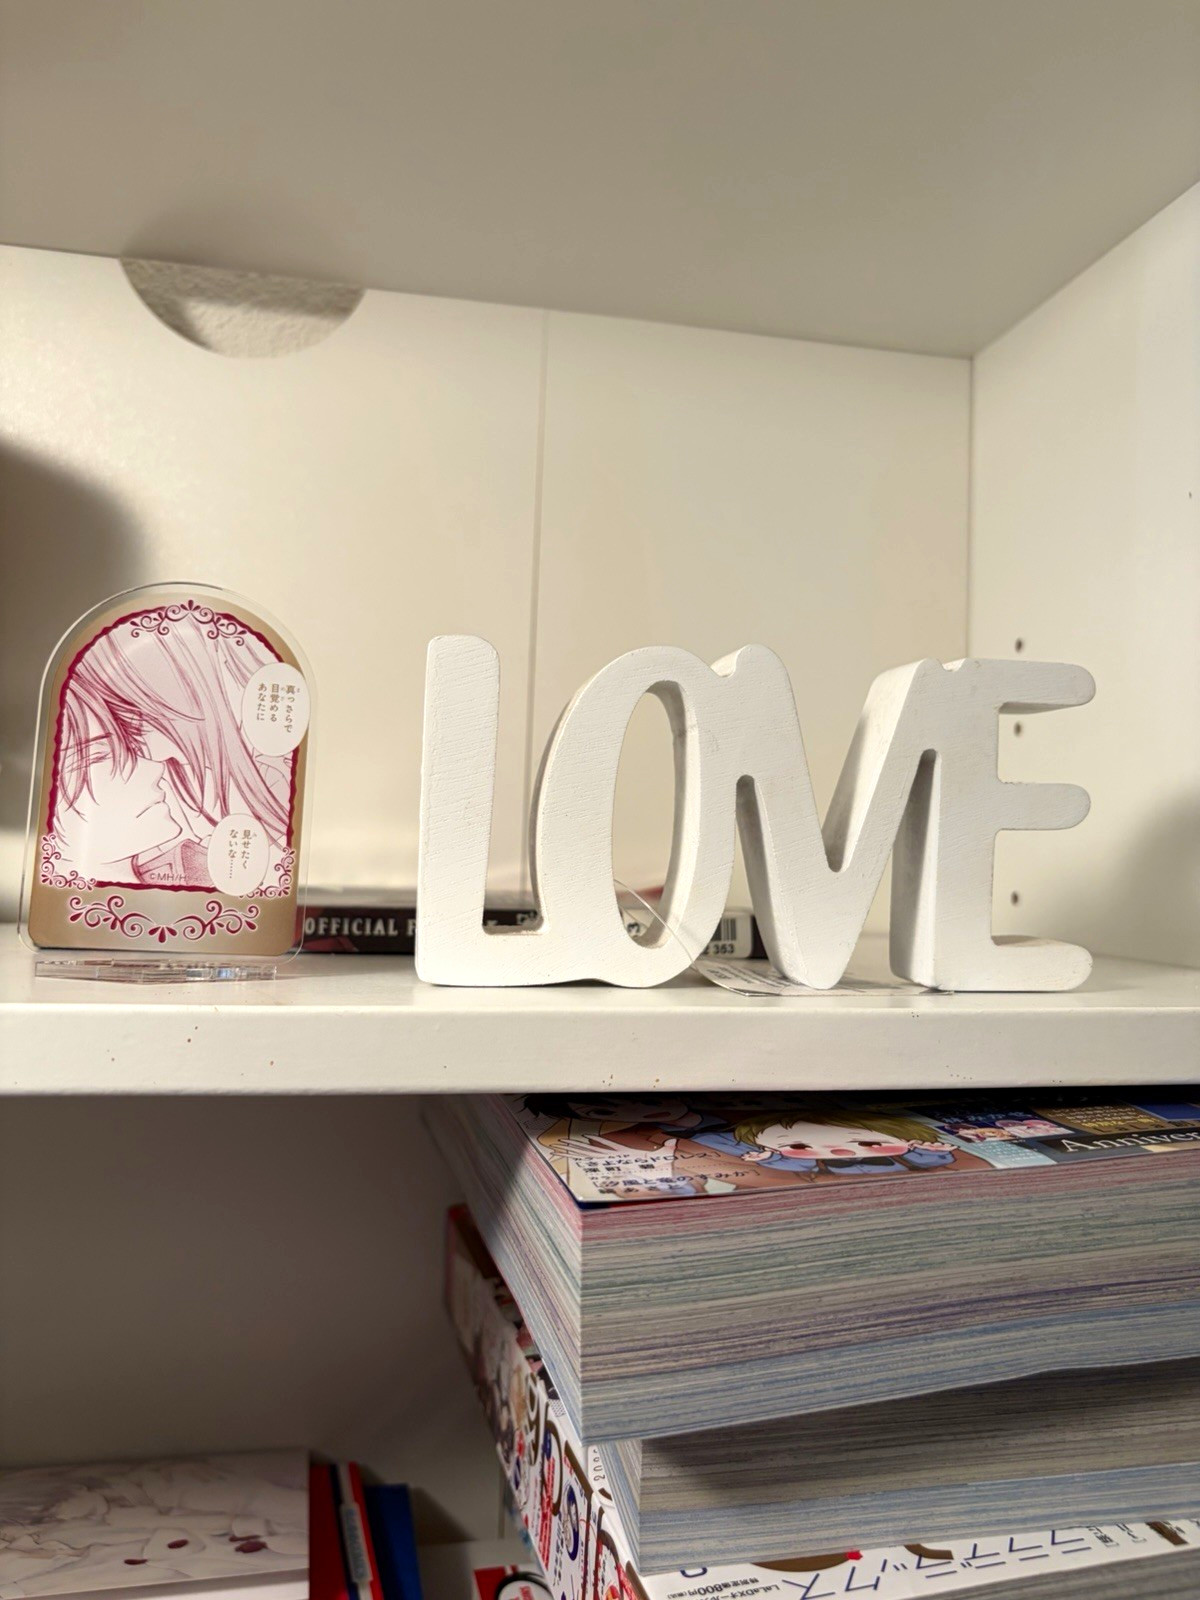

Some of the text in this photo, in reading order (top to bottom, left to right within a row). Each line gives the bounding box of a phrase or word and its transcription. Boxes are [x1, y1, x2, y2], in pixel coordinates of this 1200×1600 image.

[257, 683, 267, 721] あなたに
[270, 684, 280, 722] 目覚める
[284, 685, 296, 733] 真っさらで
[415, 634, 1096, 993] LOVE
[241, 830, 252, 869] 見せたく
[304, 917, 398, 936] OFFICIAL
[782, 1529, 1086, 1600] ララデラックス
